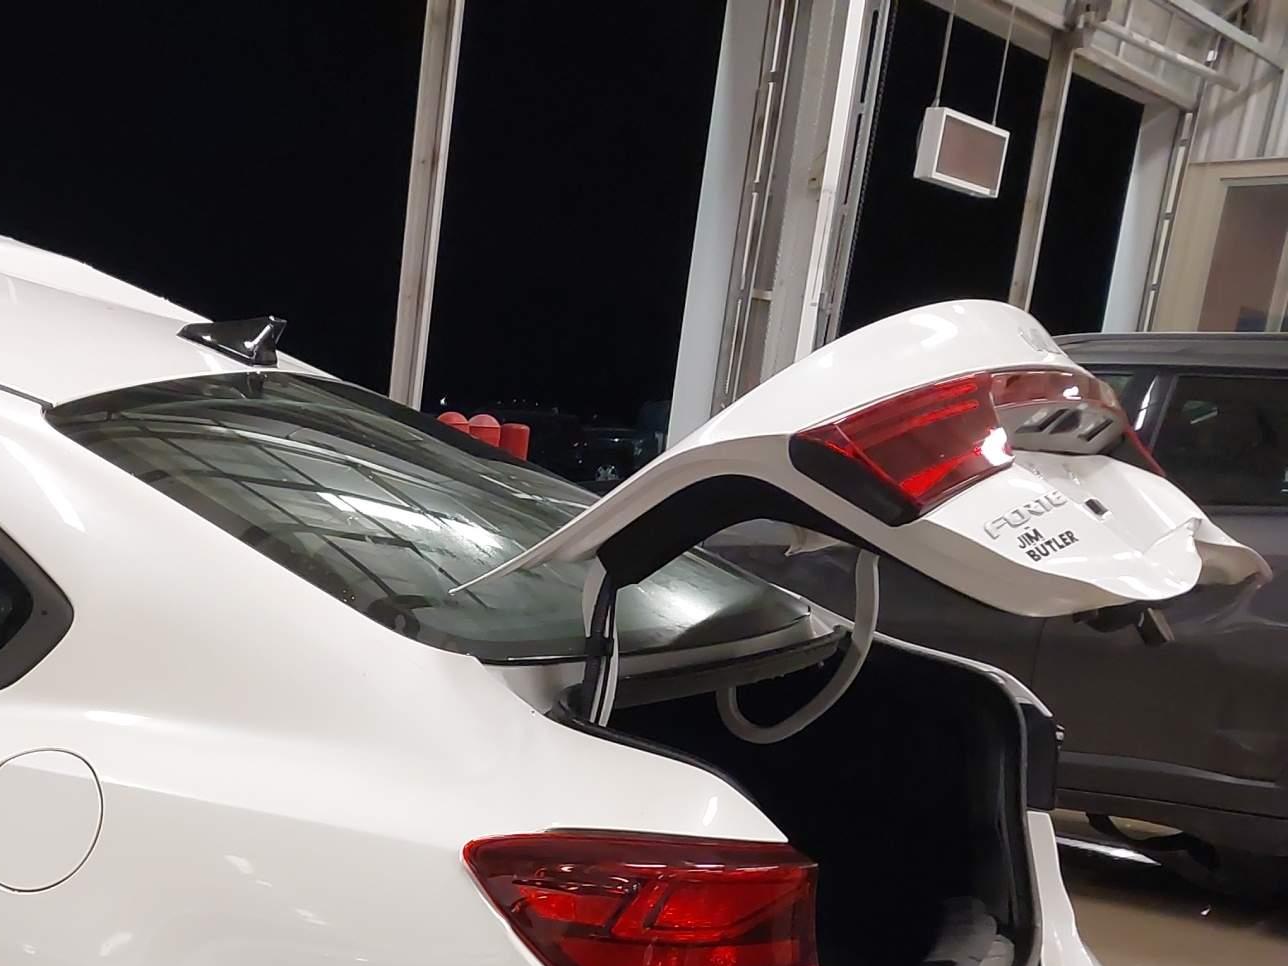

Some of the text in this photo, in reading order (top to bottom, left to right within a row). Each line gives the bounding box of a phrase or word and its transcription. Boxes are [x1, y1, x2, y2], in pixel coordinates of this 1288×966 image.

[984, 490, 1068, 540] FORTE
[1017, 528, 1044, 549] JIM
[1025, 530, 1080, 562] BUTLER
